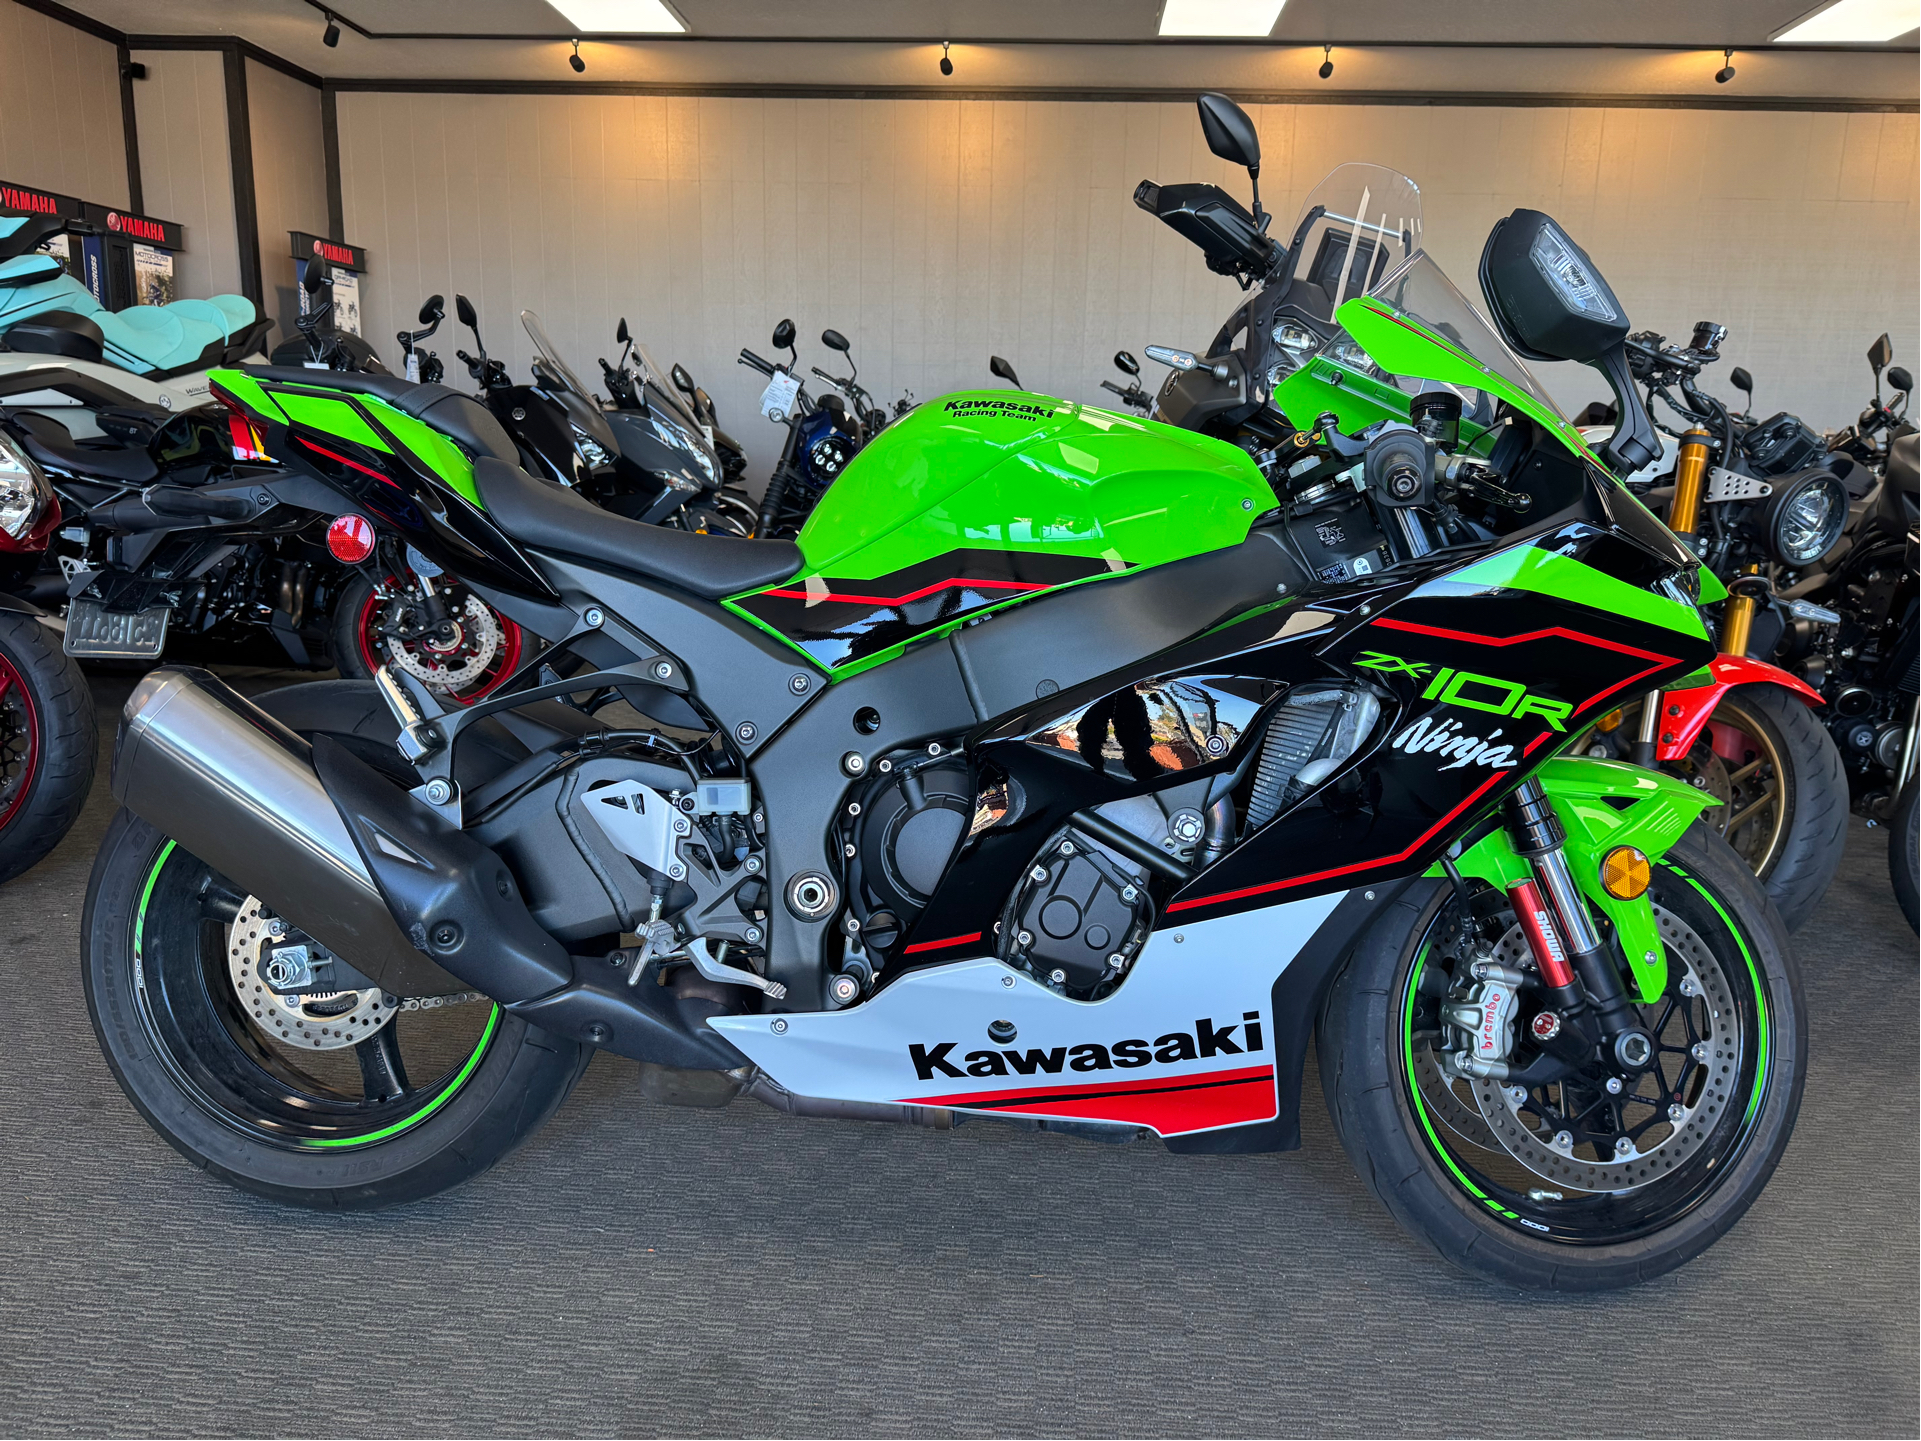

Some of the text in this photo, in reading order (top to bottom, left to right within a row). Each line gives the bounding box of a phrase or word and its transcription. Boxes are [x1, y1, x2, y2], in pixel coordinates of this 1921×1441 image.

[2, 187, 57, 214] YAMAHA
[120, 215, 165, 242] YAMAHA
[323, 242, 354, 265] YAMAHA
[90, 254, 100, 302] OTOCROSS
[943, 400, 1055, 419] Kawasaki
[952, 409, 1037, 422] Racing Team
[1352, 650, 1574, 733] ZX-10R
[1391, 716, 1518, 771] Ninja
[1533, 910, 1565, 962] SHOWA
[908, 1010, 1264, 1081] Kawasaki
[1481, 993, 1501, 1051] brembo
